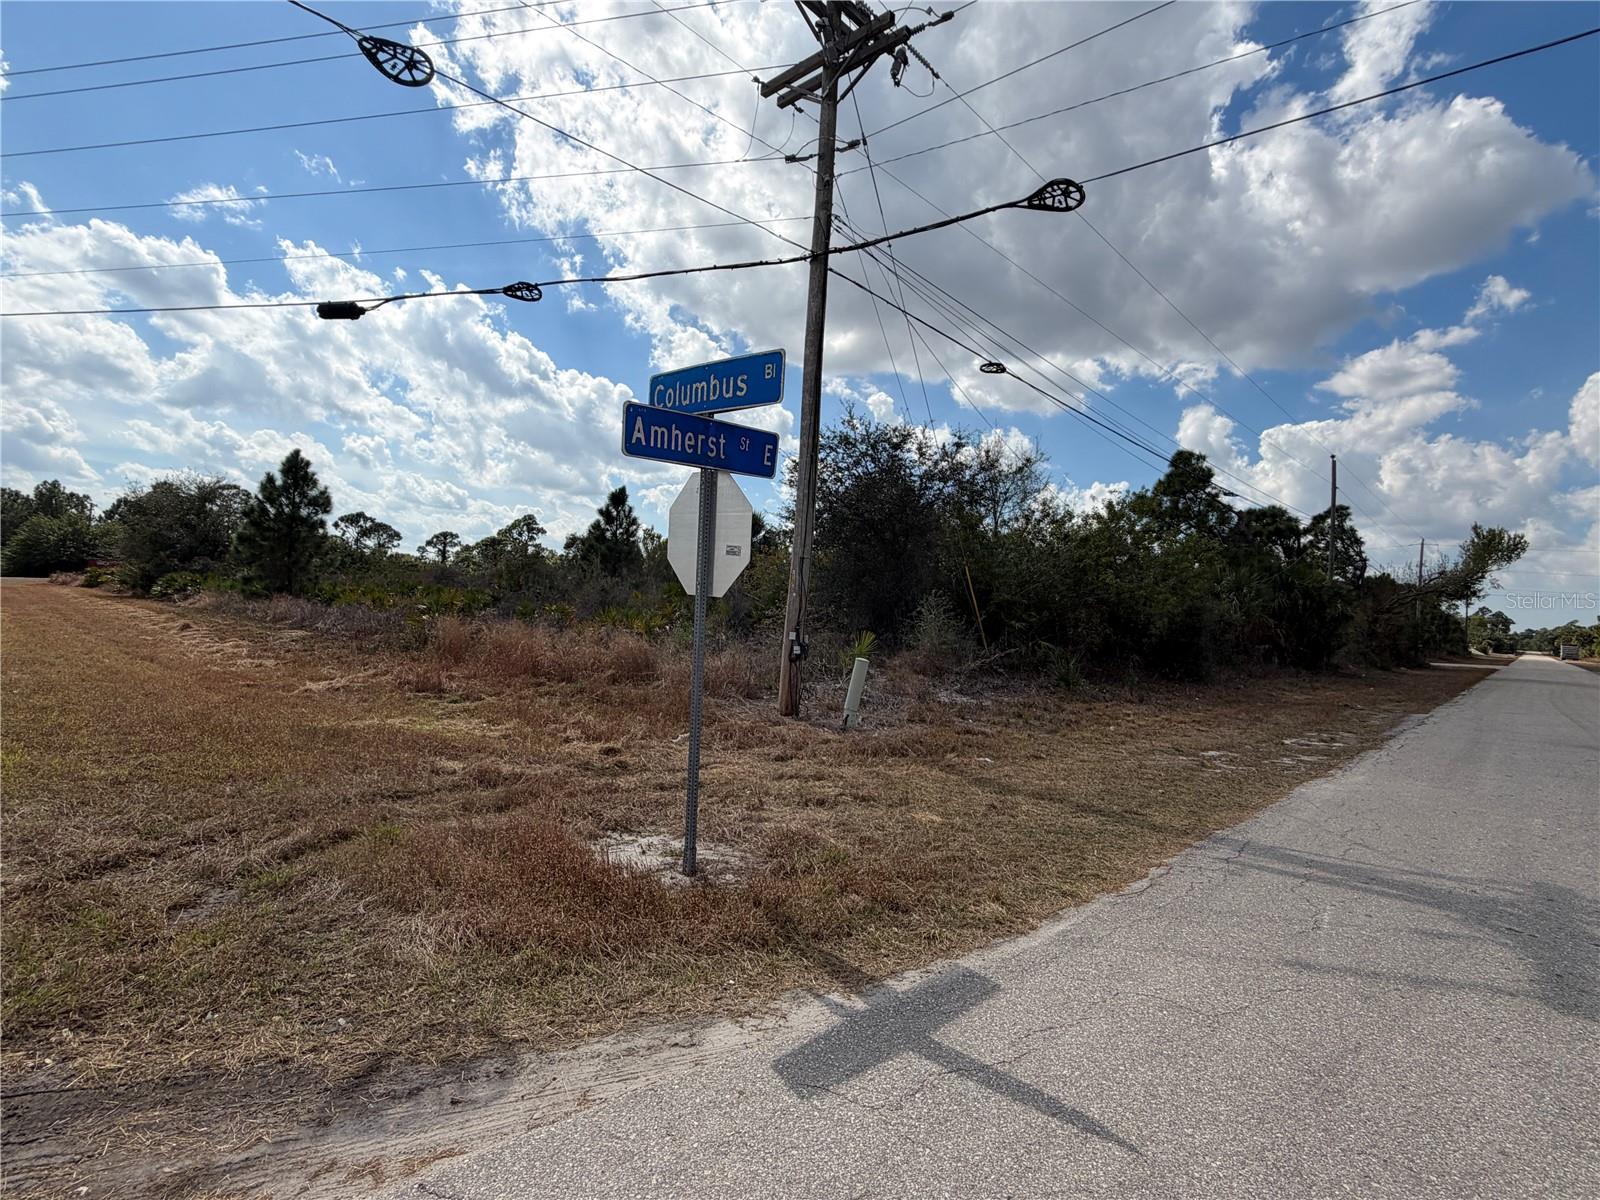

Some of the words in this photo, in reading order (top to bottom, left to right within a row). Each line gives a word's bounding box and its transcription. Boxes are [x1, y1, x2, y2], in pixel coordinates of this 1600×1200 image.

[654, 373, 748, 409] Columbus
[764, 363, 776, 379] Bl
[631, 416, 726, 460] Amherst
[739, 436, 750, 452] St
[763, 444, 774, 466] E
